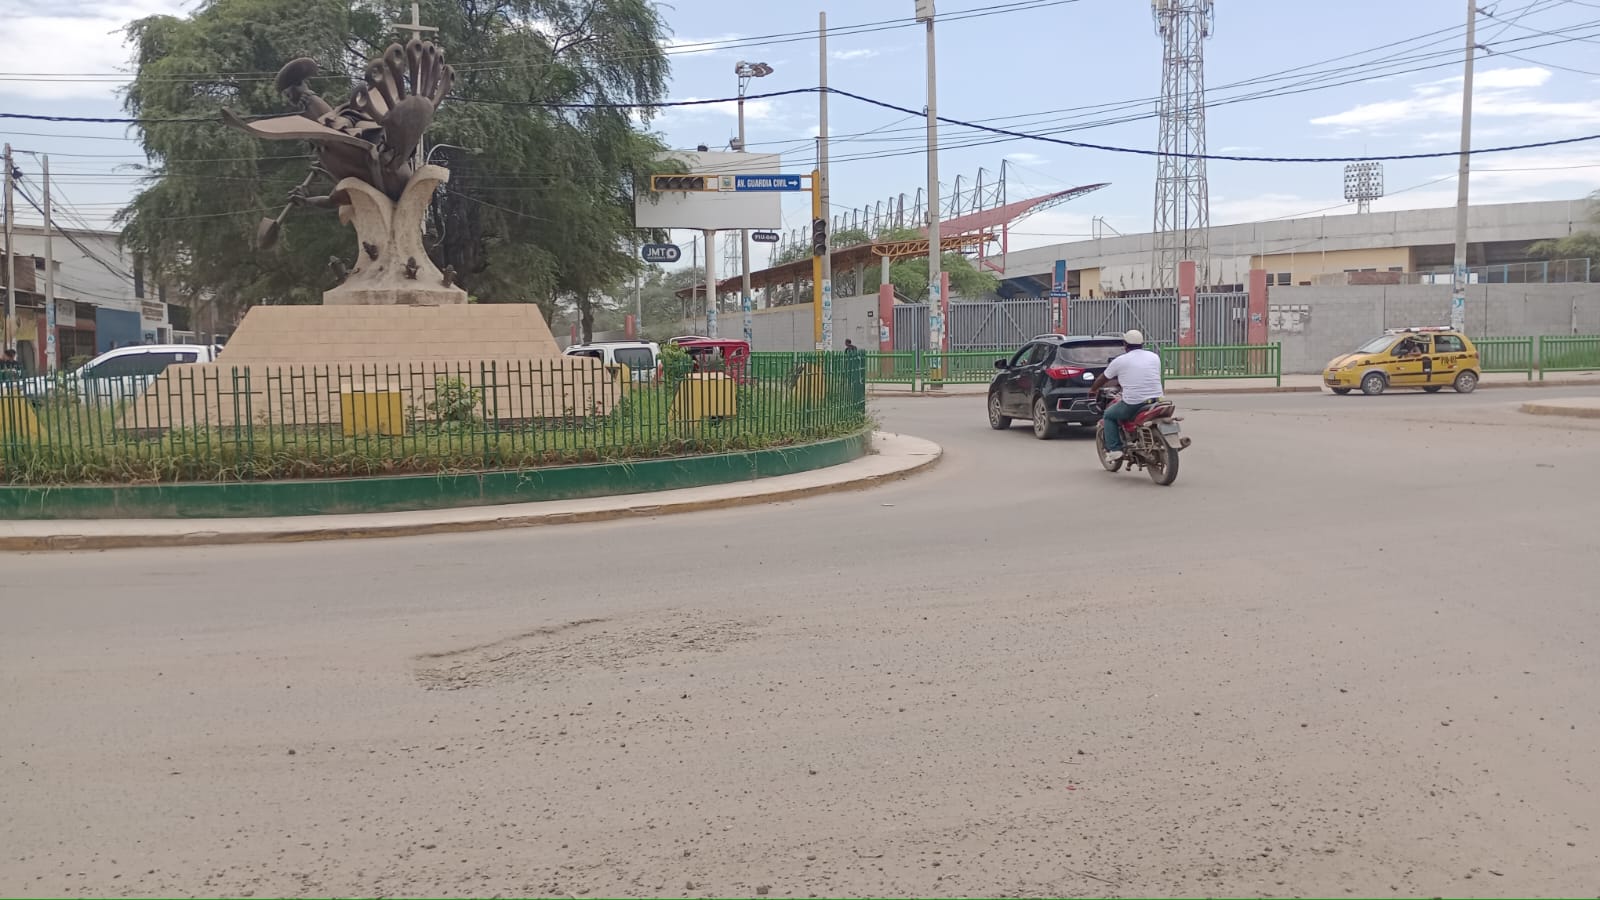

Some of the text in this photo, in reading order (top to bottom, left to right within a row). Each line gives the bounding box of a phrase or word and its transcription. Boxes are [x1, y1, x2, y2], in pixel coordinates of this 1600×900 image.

[736, 179, 788, 188] AV. GUARDIA CIVIL
